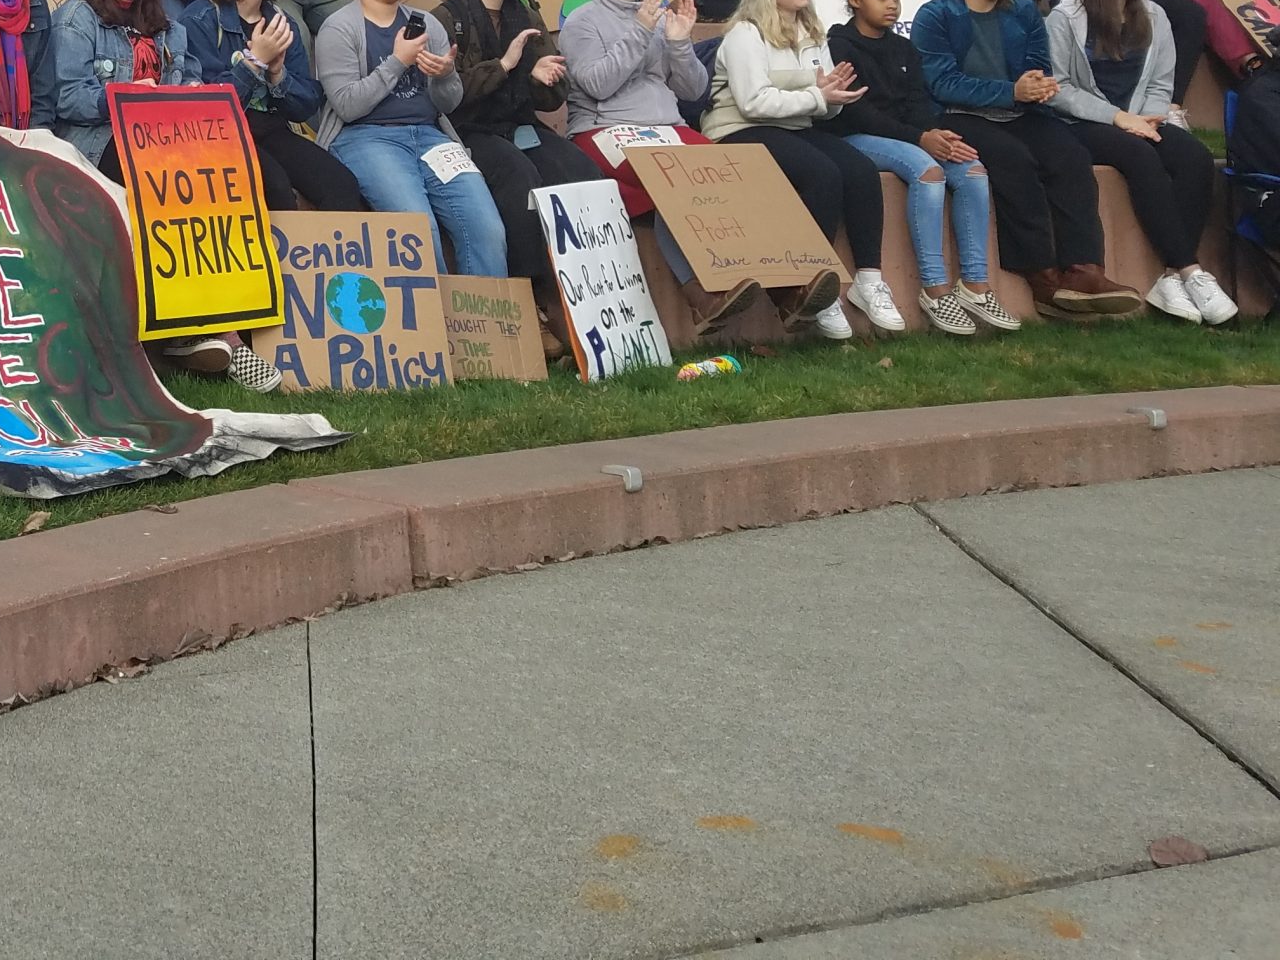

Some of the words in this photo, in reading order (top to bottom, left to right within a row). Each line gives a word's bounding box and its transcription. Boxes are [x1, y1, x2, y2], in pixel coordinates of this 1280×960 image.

[133, 117, 230, 152] ORGANIZE
[143, 166, 243, 207] VOTE
[651, 151, 744, 188] Planet
[691, 195, 729, 207] over
[270, 222, 373, 271] Denial
[386, 228, 424, 271] is
[549, 193, 617, 256] Activism
[148, 213, 265, 281] STRIKE
[558, 269, 585, 307] Our
[611, 259, 646, 295] Living
[283, 272, 437, 339] NOT
[601, 305, 618, 330] on
[618, 299, 636, 326] the
[457, 338, 494, 358] TIME
[496, 320, 522, 336] THEY
[274, 343, 312, 387] A
[327, 334, 447, 390] Policy
[585, 320, 663, 381] PLANET
